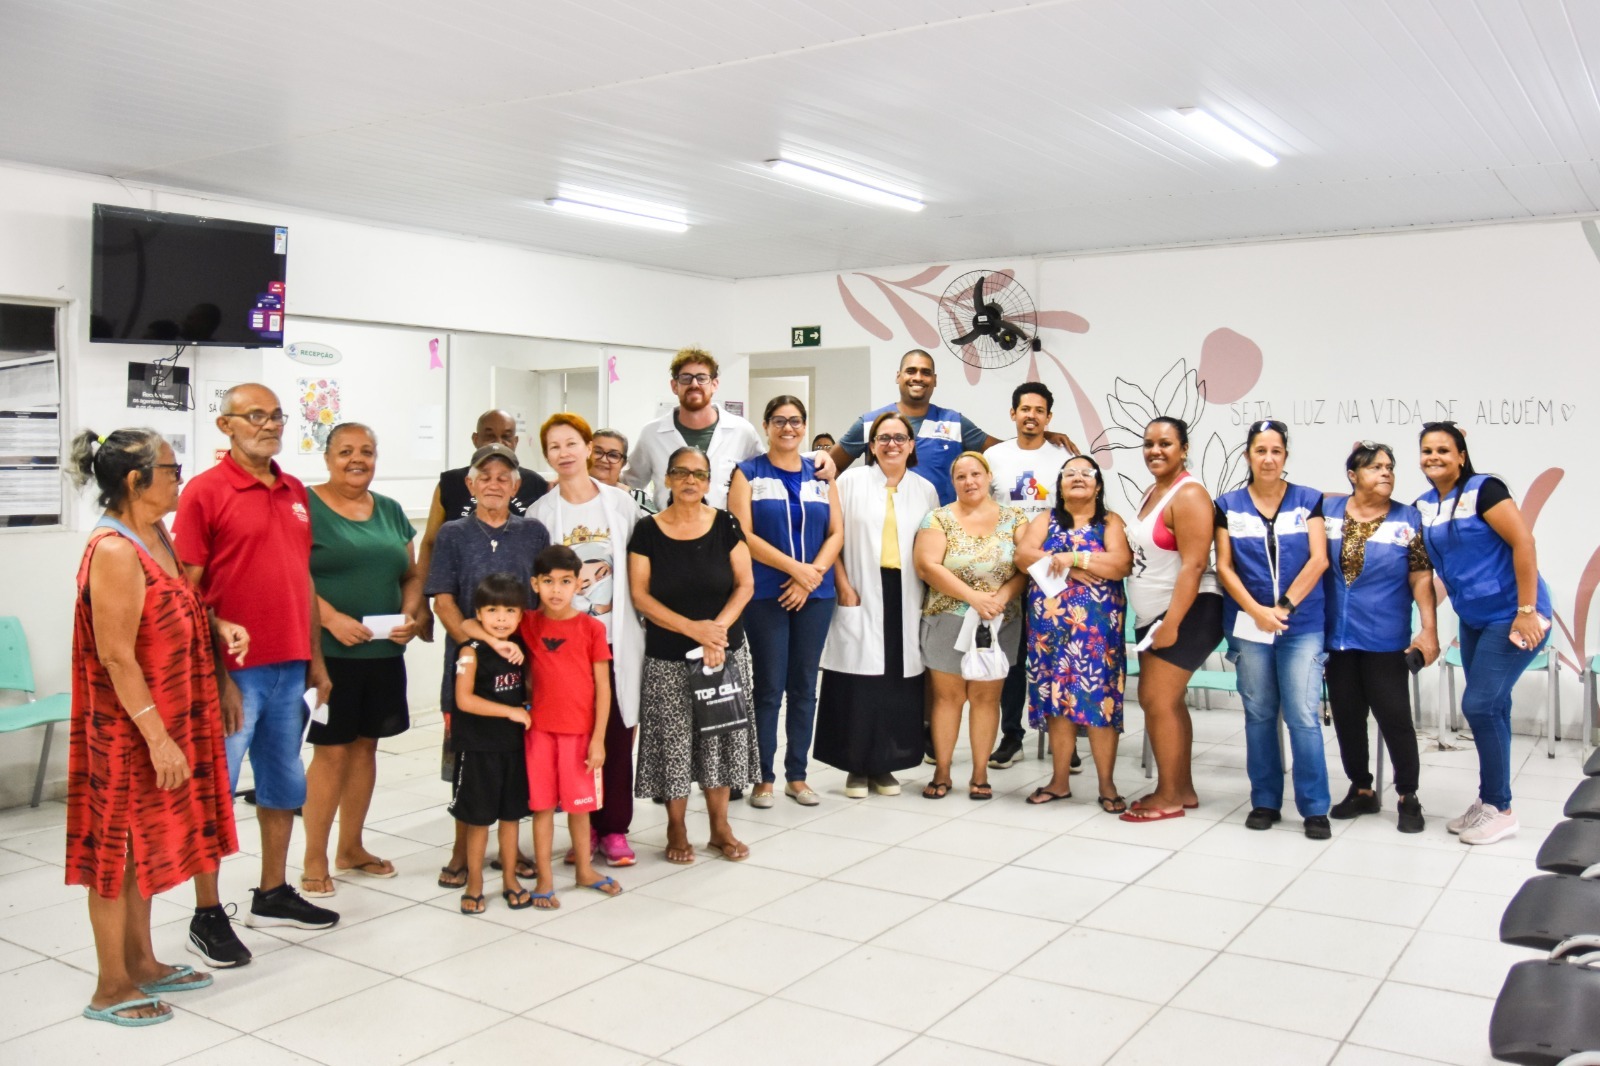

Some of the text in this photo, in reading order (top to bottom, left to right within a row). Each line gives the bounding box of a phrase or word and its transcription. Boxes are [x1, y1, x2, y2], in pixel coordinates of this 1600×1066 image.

[300, 349, 334, 359] RECEPÇÃO
[1231, 396, 1554, 426] SEJA LUZ NA VIDA DE ALGUÉM
[694, 687, 716, 700] TOP
